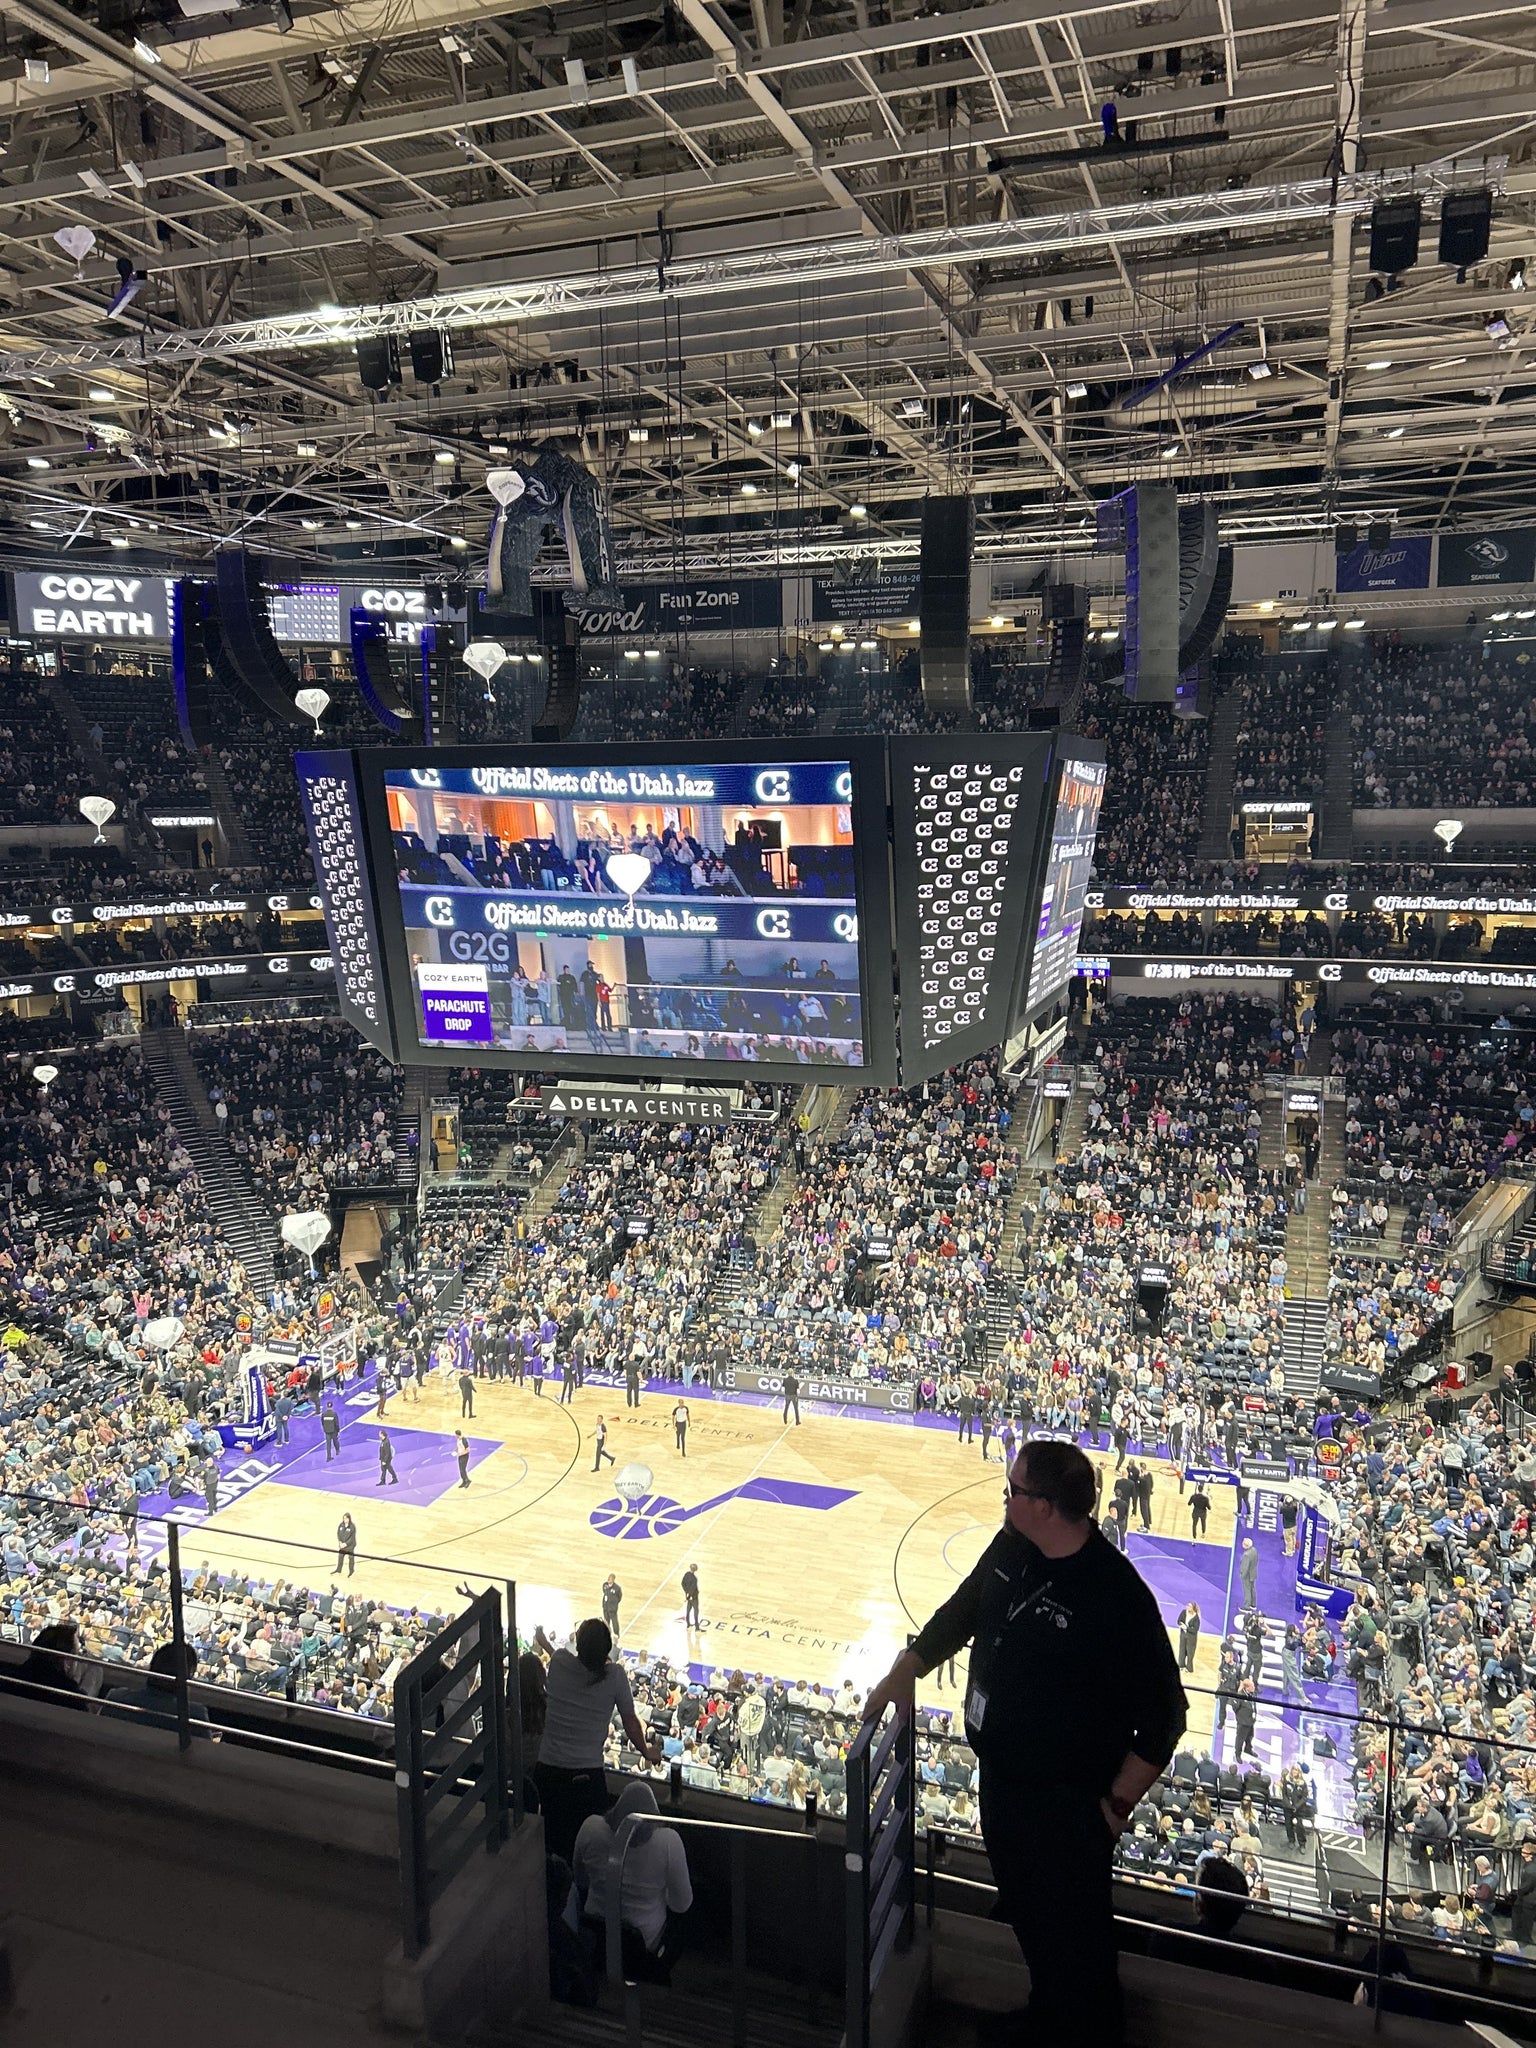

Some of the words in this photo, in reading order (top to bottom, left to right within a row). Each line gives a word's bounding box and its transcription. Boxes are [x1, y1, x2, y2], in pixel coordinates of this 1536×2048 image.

[1367, 578, 1396, 587] SEATGEEK
[1470, 572, 1501, 581] SEATGEEK
[41, 575, 142, 603] COZY
[361, 589, 425, 613] COZ
[659, 593, 692, 609] Fan
[695, 591, 740, 607] Zone
[33, 608, 153, 636] EARTH
[471, 767, 531, 794] Official
[532, 767, 579, 792] Sheets
[580, 770, 599, 793] of
[599, 771, 628, 794] the
[628, 772, 674, 796] Utah
[675, 774, 715, 797] Jazz
[1243, 803, 1273, 812] COZY
[1273, 802, 1311, 812] EARTH
[152, 817, 180, 827] COZY
[93, 904, 134, 921] Official
[134, 903, 164, 917] Sheets
[164, 902, 177, 914] of
[177, 901, 195, 913] the
[195, 899, 223, 912] Utah
[223, 899, 246, 911] Jazz
[1128, 894, 1170, 909] Official
[1170, 894, 1205, 908] Sheets
[1206, 895, 1220, 907] of
[1220, 894, 1240, 907] the
[1241, 894, 1271, 908] Utah
[1271, 894, 1299, 908] Jazz
[1374, 895, 1422, 912] Official
[1422, 896, 1460, 910] Sheets
[1460, 896, 1476, 911] of
[1476, 897, 1498, 911] the
[1499, 898, 1530, 912] Utah
[5, 913, 31, 926] Jazz
[484, 902, 541, 930] Official
[542, 903, 588, 927] Sheets
[588, 906, 608, 929] of
[635, 908, 679, 930] Utah
[680, 910, 718, 932] Jazz
[449, 930, 510, 961] G2G
[95, 972, 135, 988] Official
[135, 970, 165, 982] Sheets
[165, 967, 178, 979] of
[178, 965, 195, 977] the
[195, 963, 223, 976] Utah
[223, 962, 246, 974] Jazz
[1173, 964, 1191, 979] PM
[1202, 964, 1216, 976] of
[1216, 964, 1235, 976] the
[1236, 964, 1266, 977] Utah
[1266, 964, 1293, 978] Jazz
[1368, 966, 1415, 984] Official
[1415, 968, 1452, 982] Sheets
[1452, 970, 1468, 984] of
[1468, 971, 1490, 985] the
[1490, 972, 1523, 987] Utah
[8, 983, 33, 996] Jazz
[426, 999, 486, 1013] PARACHUTE
[444, 1018, 472, 1031] DROP
[570, 1096, 639, 1114] DELTA
[644, 1099, 724, 1118] CENTER
[757, 1376, 805, 1394] CO
[808, 1383, 867, 1403] EARTH
[627, 1417, 674, 1429] DELT
[689, 1425, 755, 1440] CENTER
[1264, 1469, 1287, 1477] EARTH
[1258, 1492, 1278, 1532] HEALTH
[699, 1618, 771, 1639] DELTA
